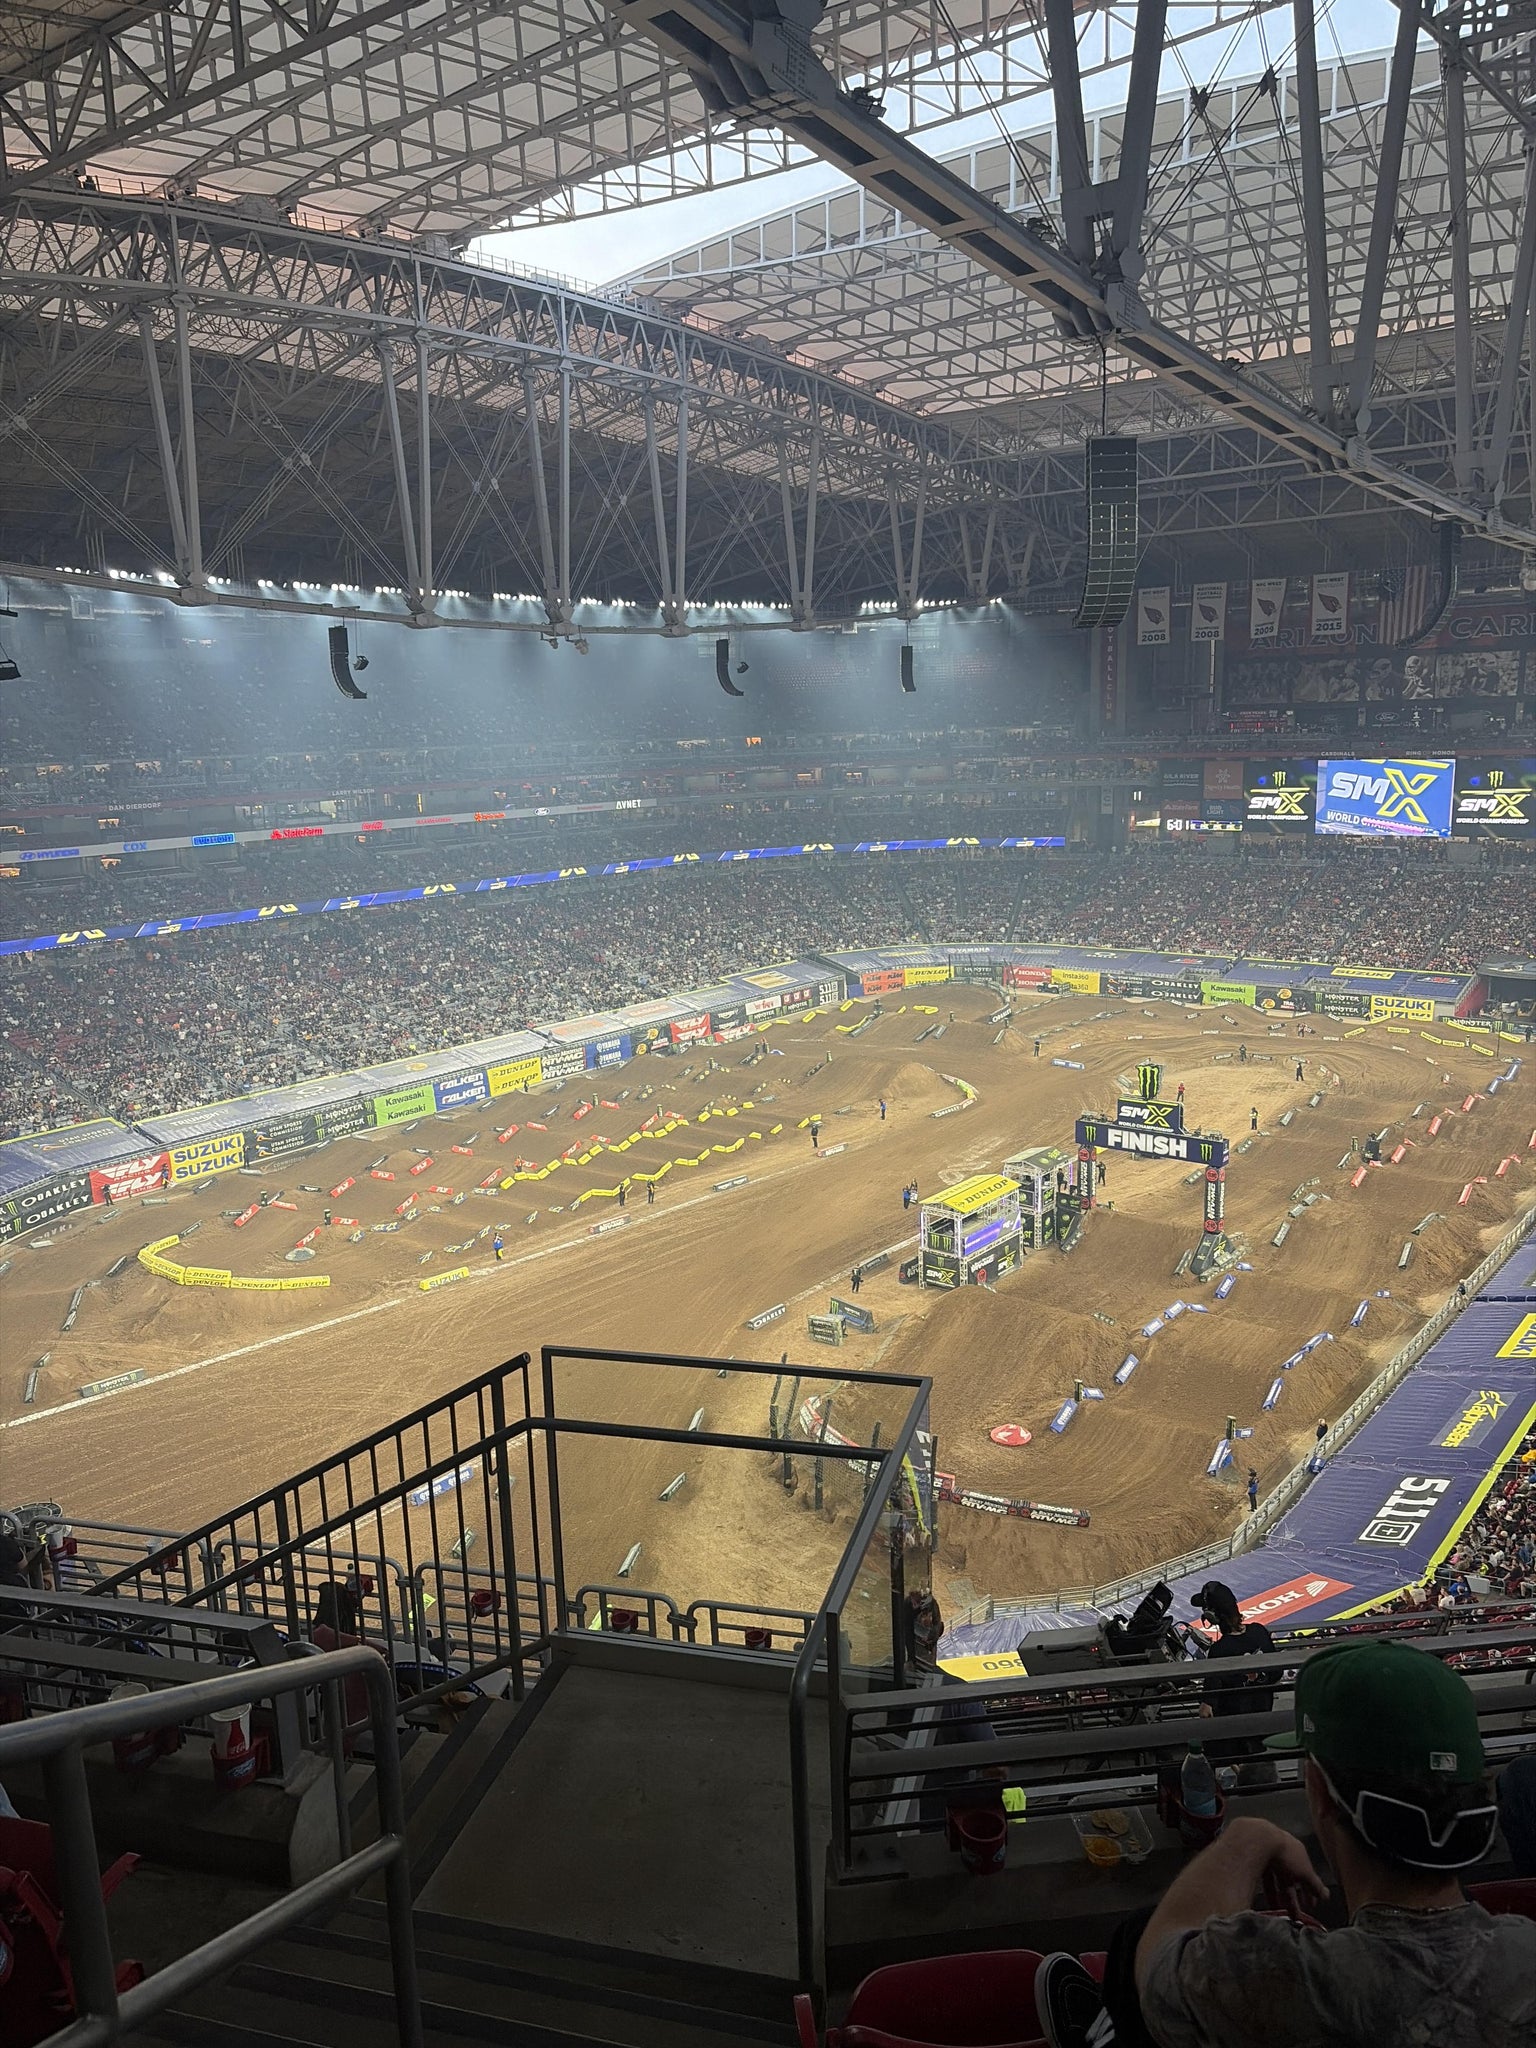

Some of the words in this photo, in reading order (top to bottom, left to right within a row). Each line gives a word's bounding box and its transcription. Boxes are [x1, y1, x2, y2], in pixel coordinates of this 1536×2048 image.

[1254, 626, 1275, 636] 2009
[1316, 622, 1342, 632] 2015
[1142, 634, 1166, 642] 2008
[1195, 631, 1219, 639] 2008
[1327, 767, 1439, 824] SMX
[126, 803, 161, 811] DIERDORF
[1249, 793, 1309, 814] SMX
[1457, 793, 1531, 817] SMX
[1326, 811, 1360, 824] WORLD
[123, 842, 148, 852] COX
[37, 849, 80, 859] HYUNDAI
[914, 969, 949, 977] DUNLOP
[1018, 969, 1047, 978] HONDA
[1335, 969, 1392, 978] SUZUKI
[1164, 981, 1199, 989] OAKLEY
[1211, 985, 1246, 993] Kawasaki
[1324, 993, 1360, 1002] MONSTER
[1374, 997, 1432, 1011] SUZUKI
[1324, 1004, 1359, 1014] MONSTER
[1453, 1018, 1492, 1027] MONSTER
[499, 1060, 539, 1077] DUNLOP
[439, 1073, 484, 1091] FALKEN
[501, 1072, 539, 1090] DUNLOP
[385, 1089, 426, 1107] Kawasaki
[441, 1086, 486, 1105] FALKEN
[325, 1103, 364, 1120] MONSTER
[387, 1104, 427, 1120] Kawasaki
[1119, 1104, 1173, 1128] SMX
[269, 1125, 282, 1133] UTAH
[283, 1120, 303, 1130] SPORTS
[269, 1125, 303, 1138] COMMISSION
[327, 1117, 366, 1134] MONSTER
[1136, 1122, 1174, 1133] CHAMPIONSHIP
[270, 1140, 284, 1148] UTAH
[284, 1134, 304, 1145] SPORTS
[271, 1139, 306, 1153] COMMISSION
[1107, 1128, 1188, 1159] FINISH
[173, 1137, 243, 1164] SUZUKI
[175, 1152, 244, 1179] SUZUKI
[415, 1161, 428, 1172] FLY
[37, 1178, 88, 1202] OAKLEY
[337, 1182, 350, 1195] FLY
[965, 1178, 1010, 1204] DUNLOP
[40, 1194, 91, 1219] OAKLEY
[240, 1208, 252, 1221] FLY
[159, 1263, 182, 1276] DUNLOP
[192, 1270, 229, 1279] DUNLOP
[192, 1279, 226, 1287] DUNLOP
[428, 1271, 466, 1288] SUZUKI
[926, 1268, 956, 1285] SMX
[241, 1281, 278, 1289] DUNLOP
[291, 1279, 328, 1288] DUNLOP
[762, 1307, 786, 1324] OAKLEY
[1509, 1320, 1536, 1356] ZUKI
[1440, 1404, 1488, 1448] alpinestars
[1376, 1476, 1451, 1522] 5.11
